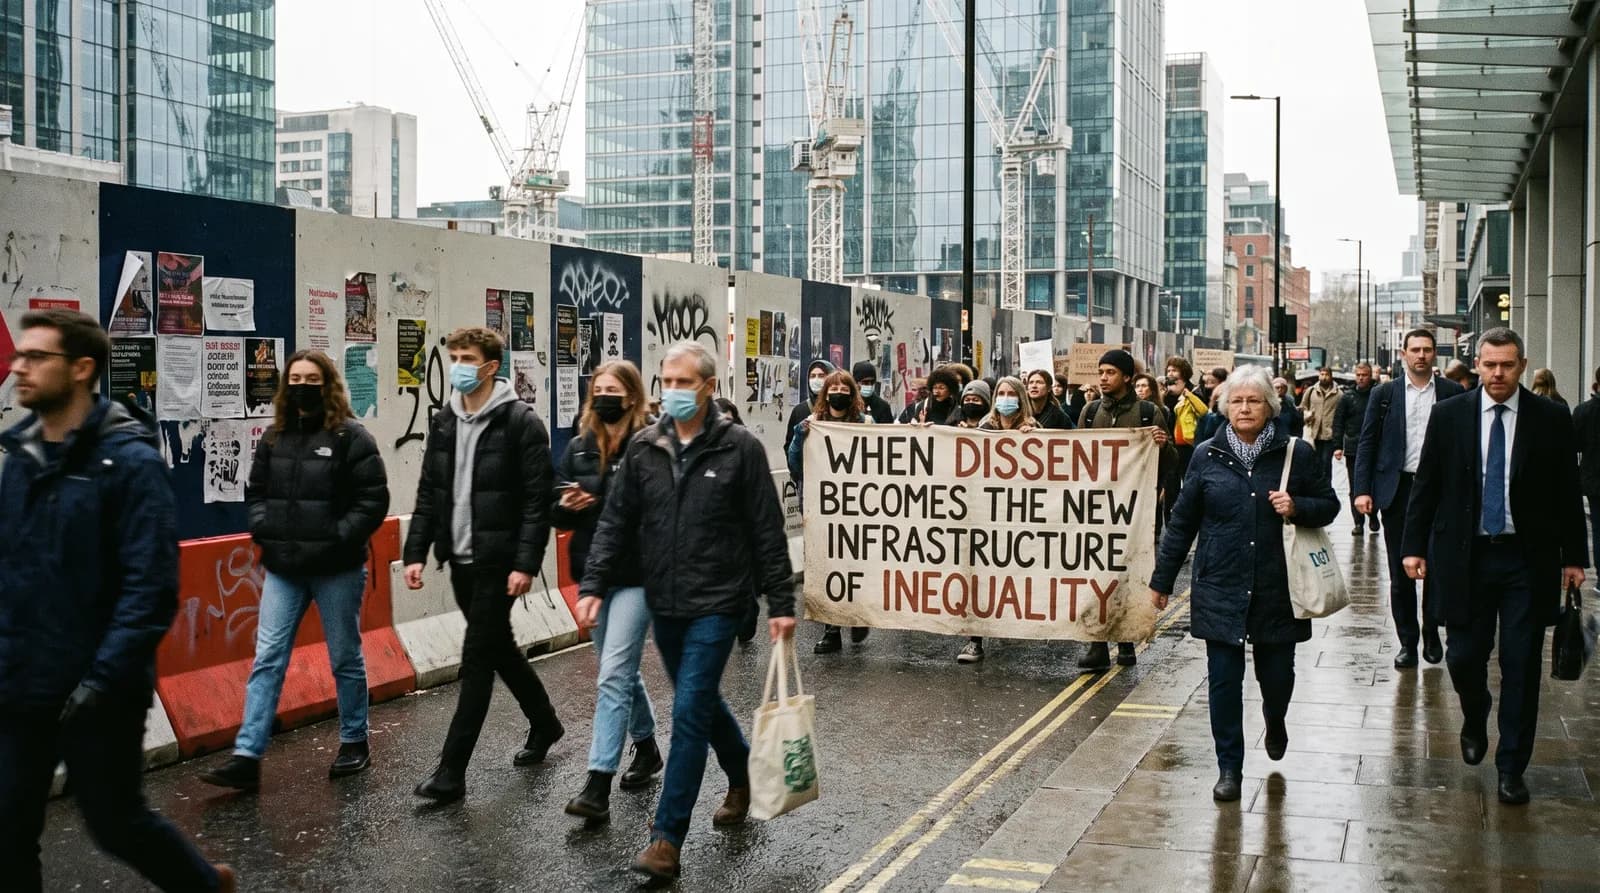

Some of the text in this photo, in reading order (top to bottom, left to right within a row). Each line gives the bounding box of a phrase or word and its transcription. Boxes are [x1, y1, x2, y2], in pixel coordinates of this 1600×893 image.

[824, 435, 1130, 482] WHEN DISSENT
[820, 481, 1138, 526] BECOMES THE NEW
[827, 523, 1128, 572] INFRASTRUCTURE
[825, 569, 1119, 625] OF INEQUALITY
